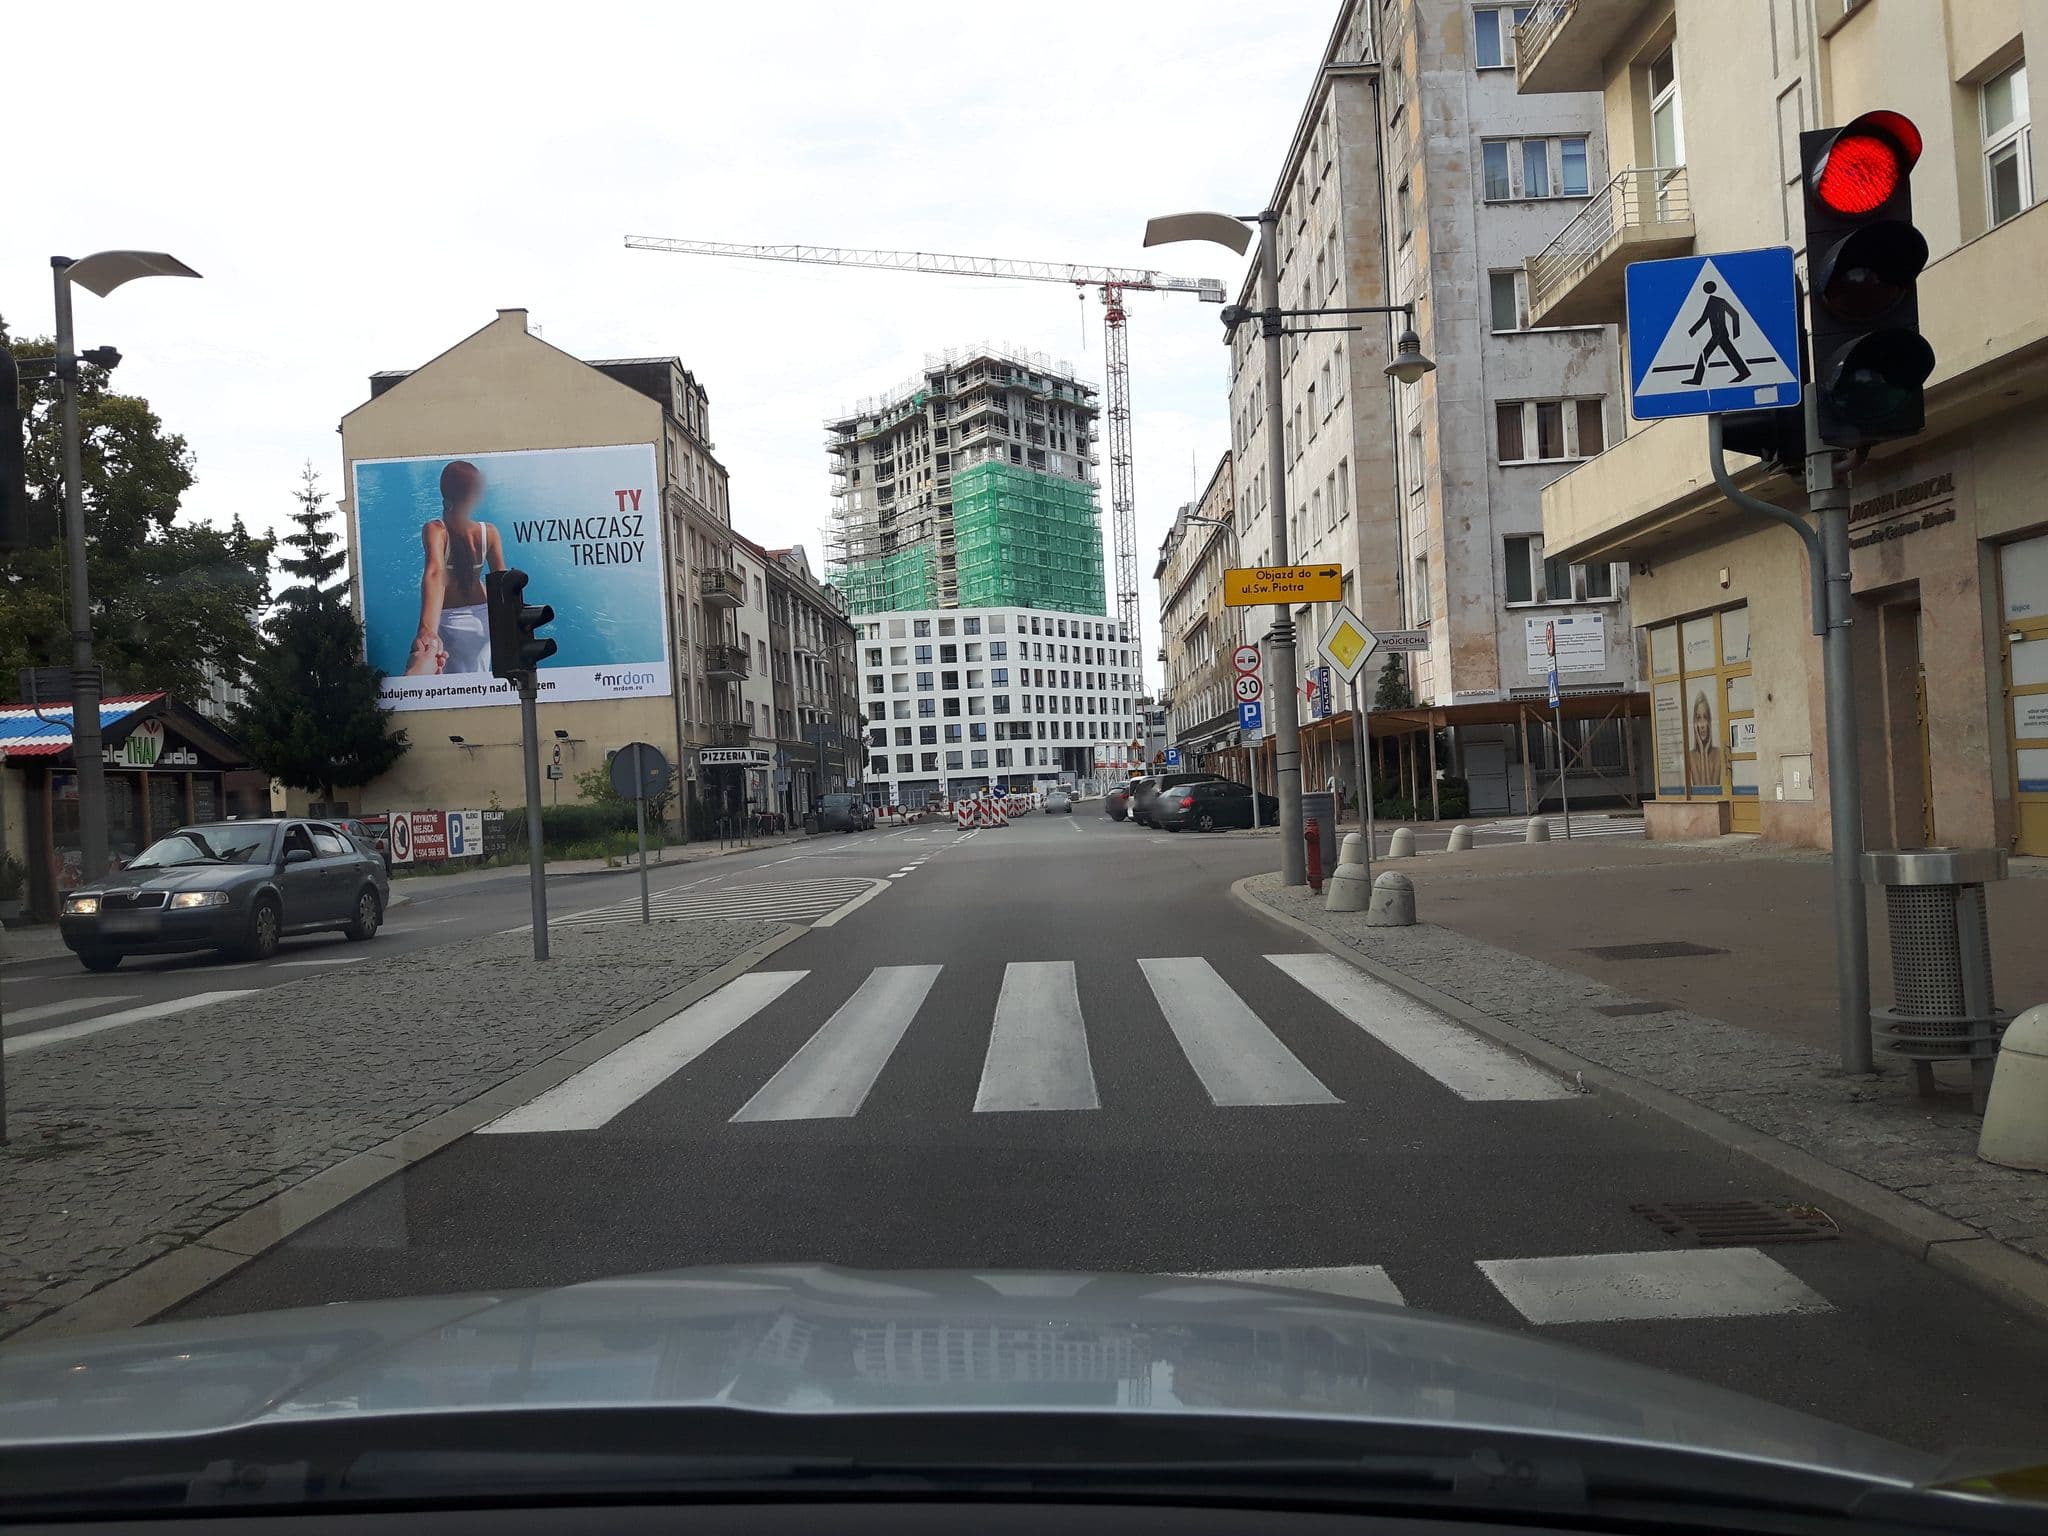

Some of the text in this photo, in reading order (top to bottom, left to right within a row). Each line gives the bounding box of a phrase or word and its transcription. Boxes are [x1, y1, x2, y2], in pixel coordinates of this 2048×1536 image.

[614, 489, 642, 512] TY
[513, 515, 645, 543] WYZNACZASZ
[570, 540, 645, 566] TRENDY
[1255, 569, 1312, 582] Objazd do
[1272, 582, 1304, 593] Piotra
[1381, 637, 1426, 645] WOJCIECHA
[594, 671, 655, 686] #mrdom
[425, 684, 488, 698] apartamenty
[489, 682, 508, 693] nad
[510, 681, 556, 692] mzem
[1238, 680, 1259, 695] 30
[1322, 671, 1331, 710] POLICJA
[1244, 704, 1257, 722] P
[125, 736, 156, 765] THAI
[701, 751, 747, 761] PIZZERIA
[1168, 750, 1176, 761] P
[412, 814, 438, 824] PRYWATNE
[452, 820, 460, 849] P
